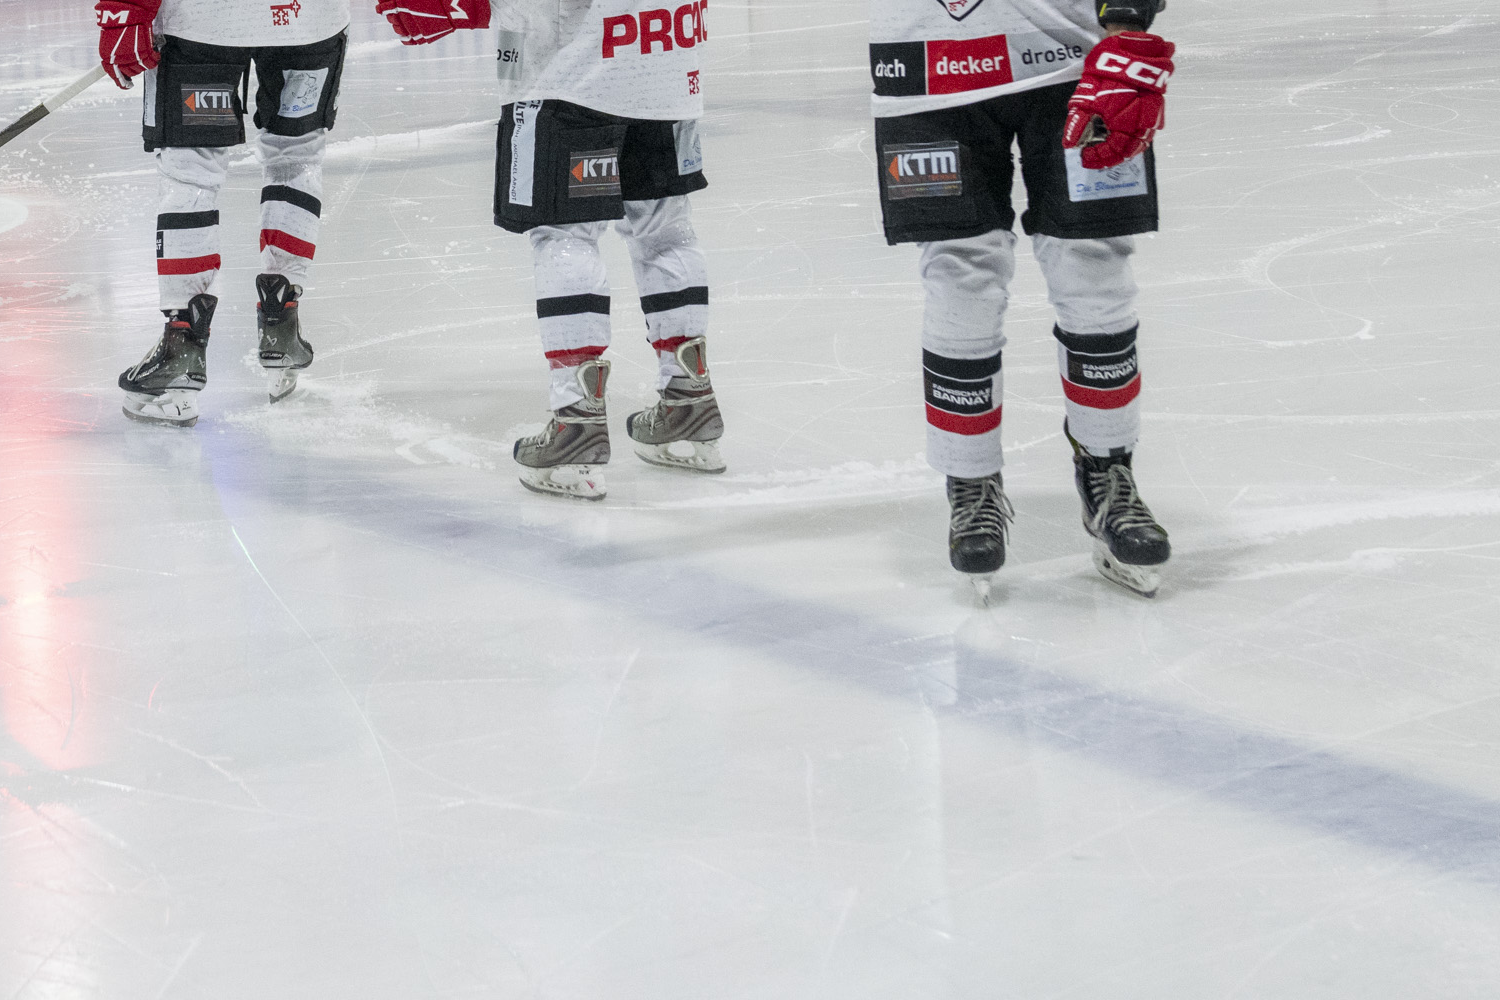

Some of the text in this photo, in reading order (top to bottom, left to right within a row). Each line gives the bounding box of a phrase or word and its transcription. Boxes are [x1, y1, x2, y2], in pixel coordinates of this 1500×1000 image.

[935, 54, 1005, 76] decker
[1022, 43, 1084, 65] droste
[896, 151, 957, 177] KTM
[509, 176, 517, 201] ARNDT
[933, 389, 992, 406] BANNAT
